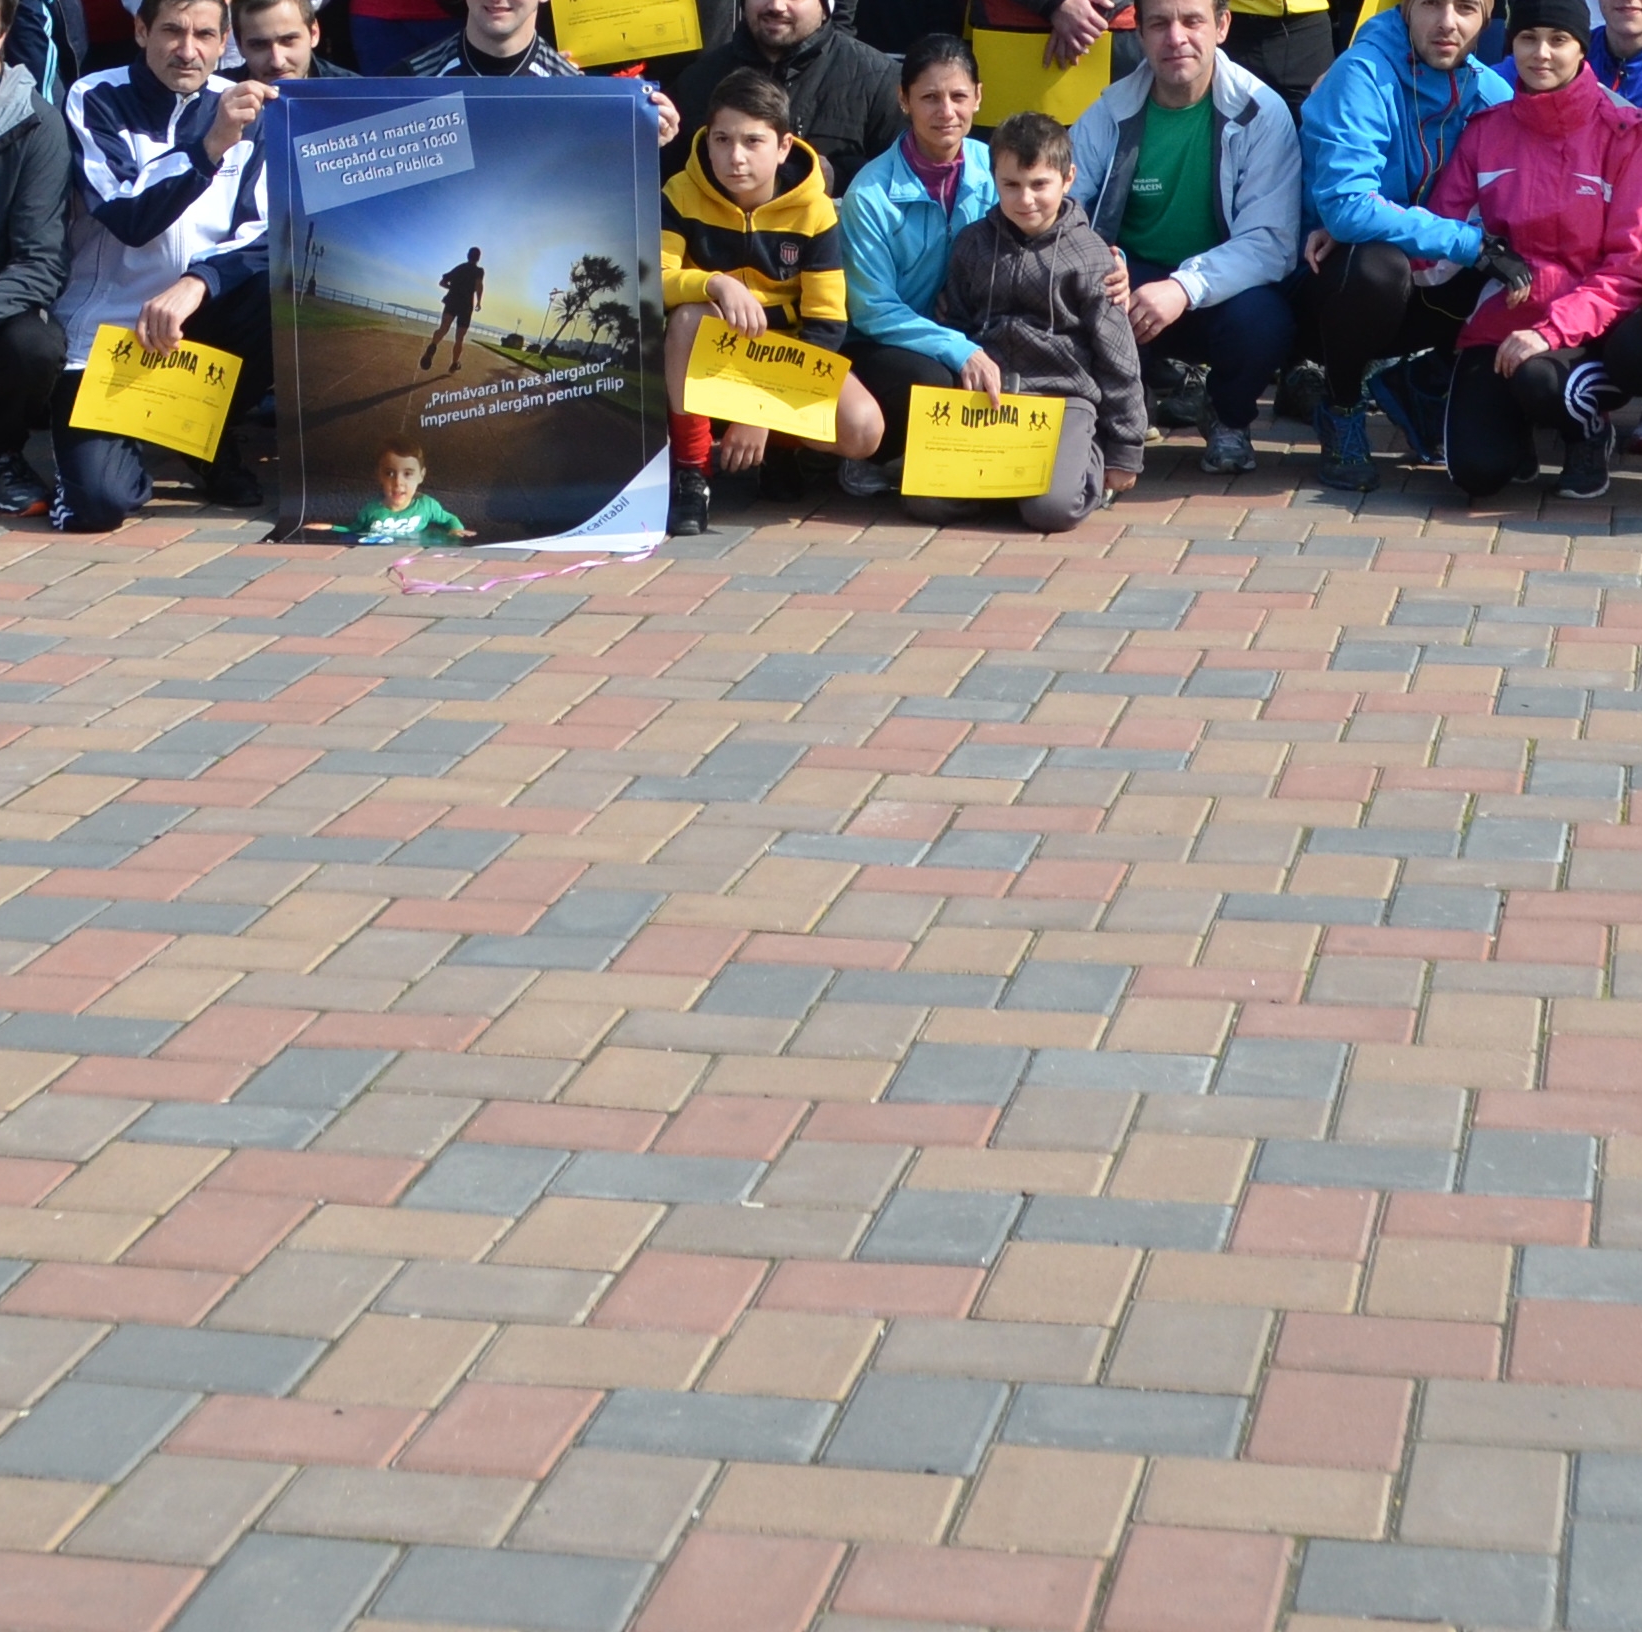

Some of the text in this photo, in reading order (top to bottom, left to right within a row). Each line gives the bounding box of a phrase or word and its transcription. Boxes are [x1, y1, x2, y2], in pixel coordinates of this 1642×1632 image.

[301, 112, 465, 158] Sâmbătă 14 martie 2015,
[379, 147, 396, 159] cu
[398, 142, 420, 155] ora
[422, 131, 458, 149] 10:00
[342, 153, 444, 186] Grădina Publică
[746, 339, 806, 369] DIPLOMA
[488, 394, 544, 413] alergăm
[546, 384, 593, 406] pentru
[595, 376, 624, 393] Filip
[501, 378, 515, 392] în
[517, 374, 541, 392] pas
[961, 405, 1019, 428] DIPLOMA
[586, 495, 630, 531] caritabil
